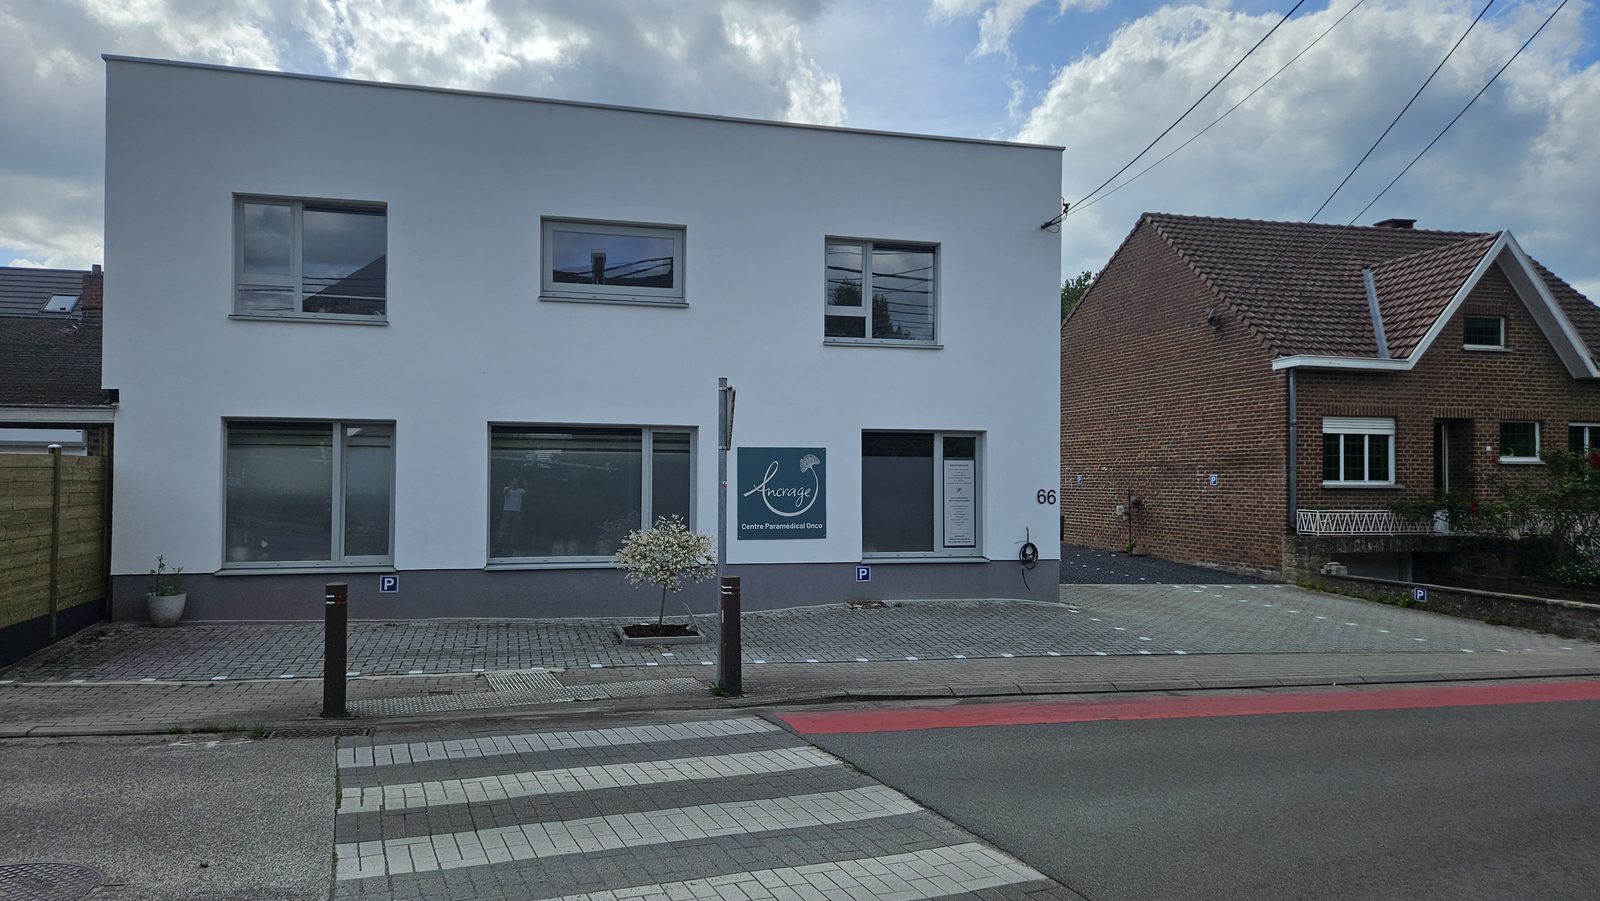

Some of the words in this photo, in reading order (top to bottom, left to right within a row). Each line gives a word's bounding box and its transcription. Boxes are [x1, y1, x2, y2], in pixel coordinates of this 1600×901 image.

[744, 461, 811, 508] Ancrage
[1037, 489, 1056, 504] 66
[765, 522, 805, 530] Paramédical
[859, 568, 868, 580] P
[384, 578, 394, 590] P
[1417, 590, 1424, 599] P
